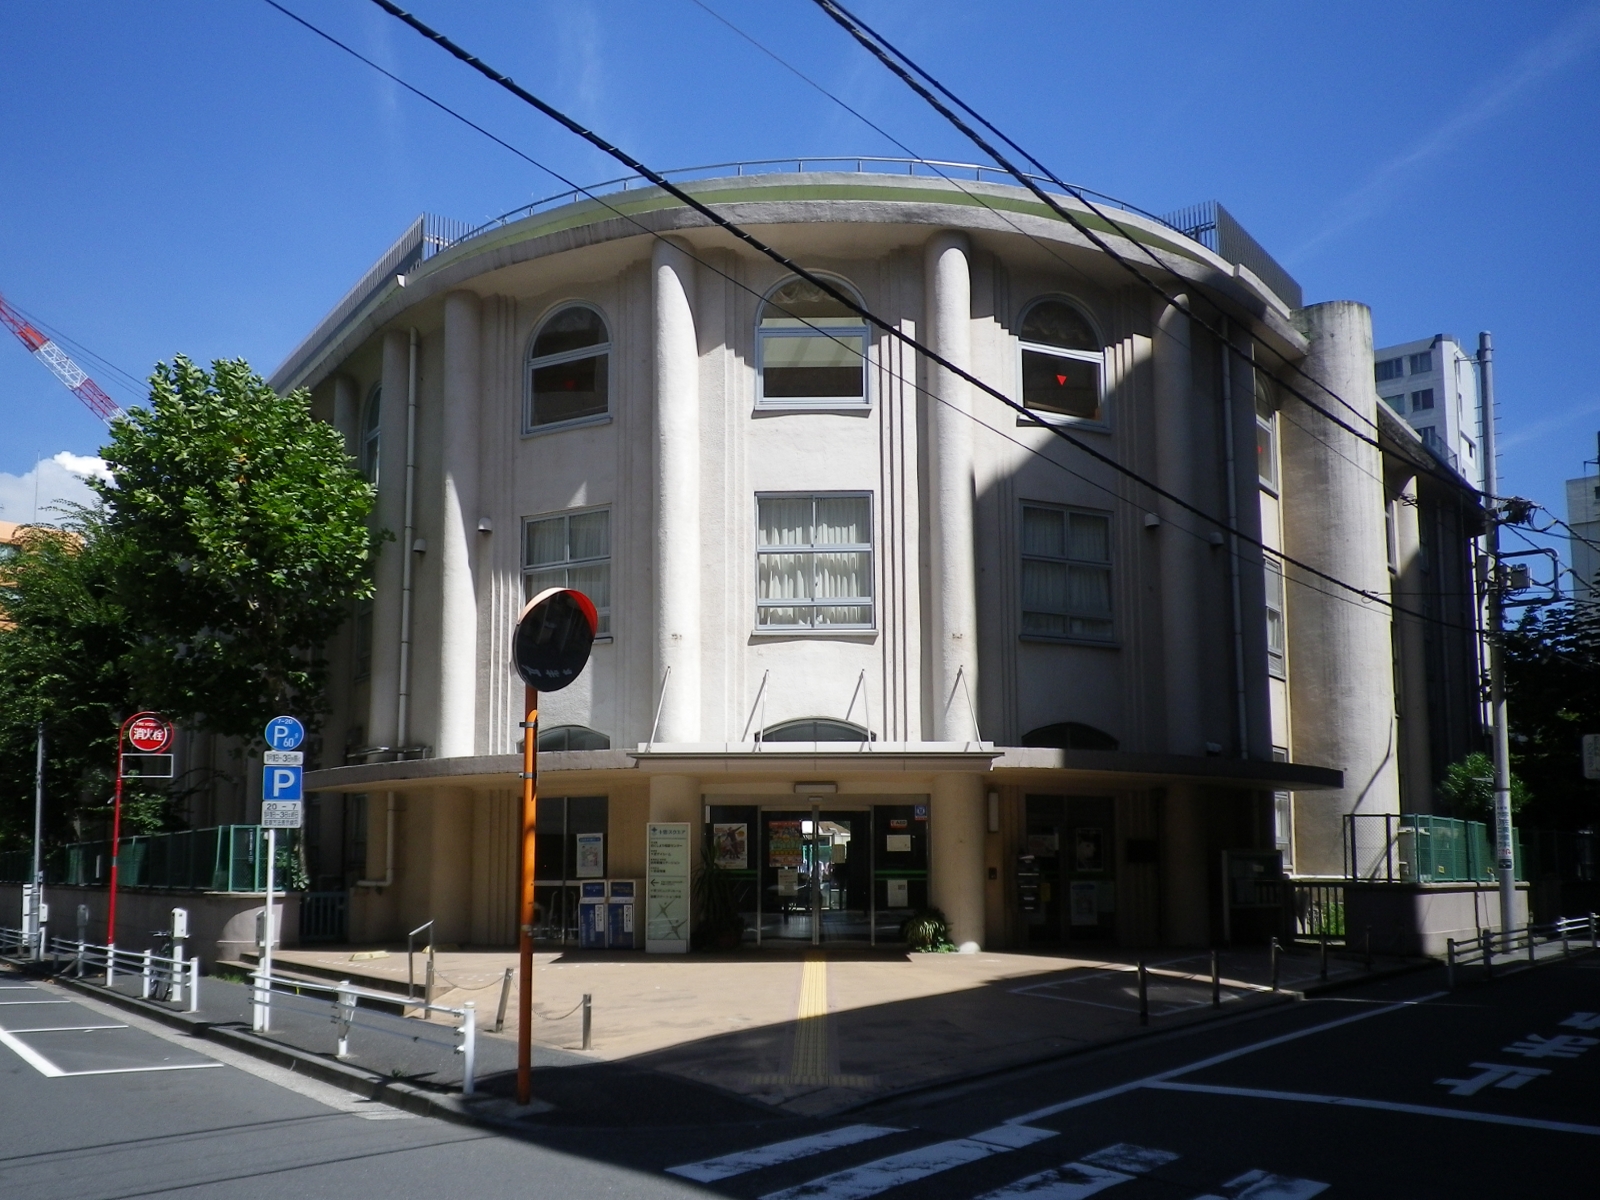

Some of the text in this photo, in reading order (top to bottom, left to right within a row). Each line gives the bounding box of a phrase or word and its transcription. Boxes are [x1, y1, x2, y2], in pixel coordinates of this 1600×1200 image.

[133, 728, 164, 741] 消火栓
[274, 726, 289, 747] P
[273, 769, 295, 797] P
